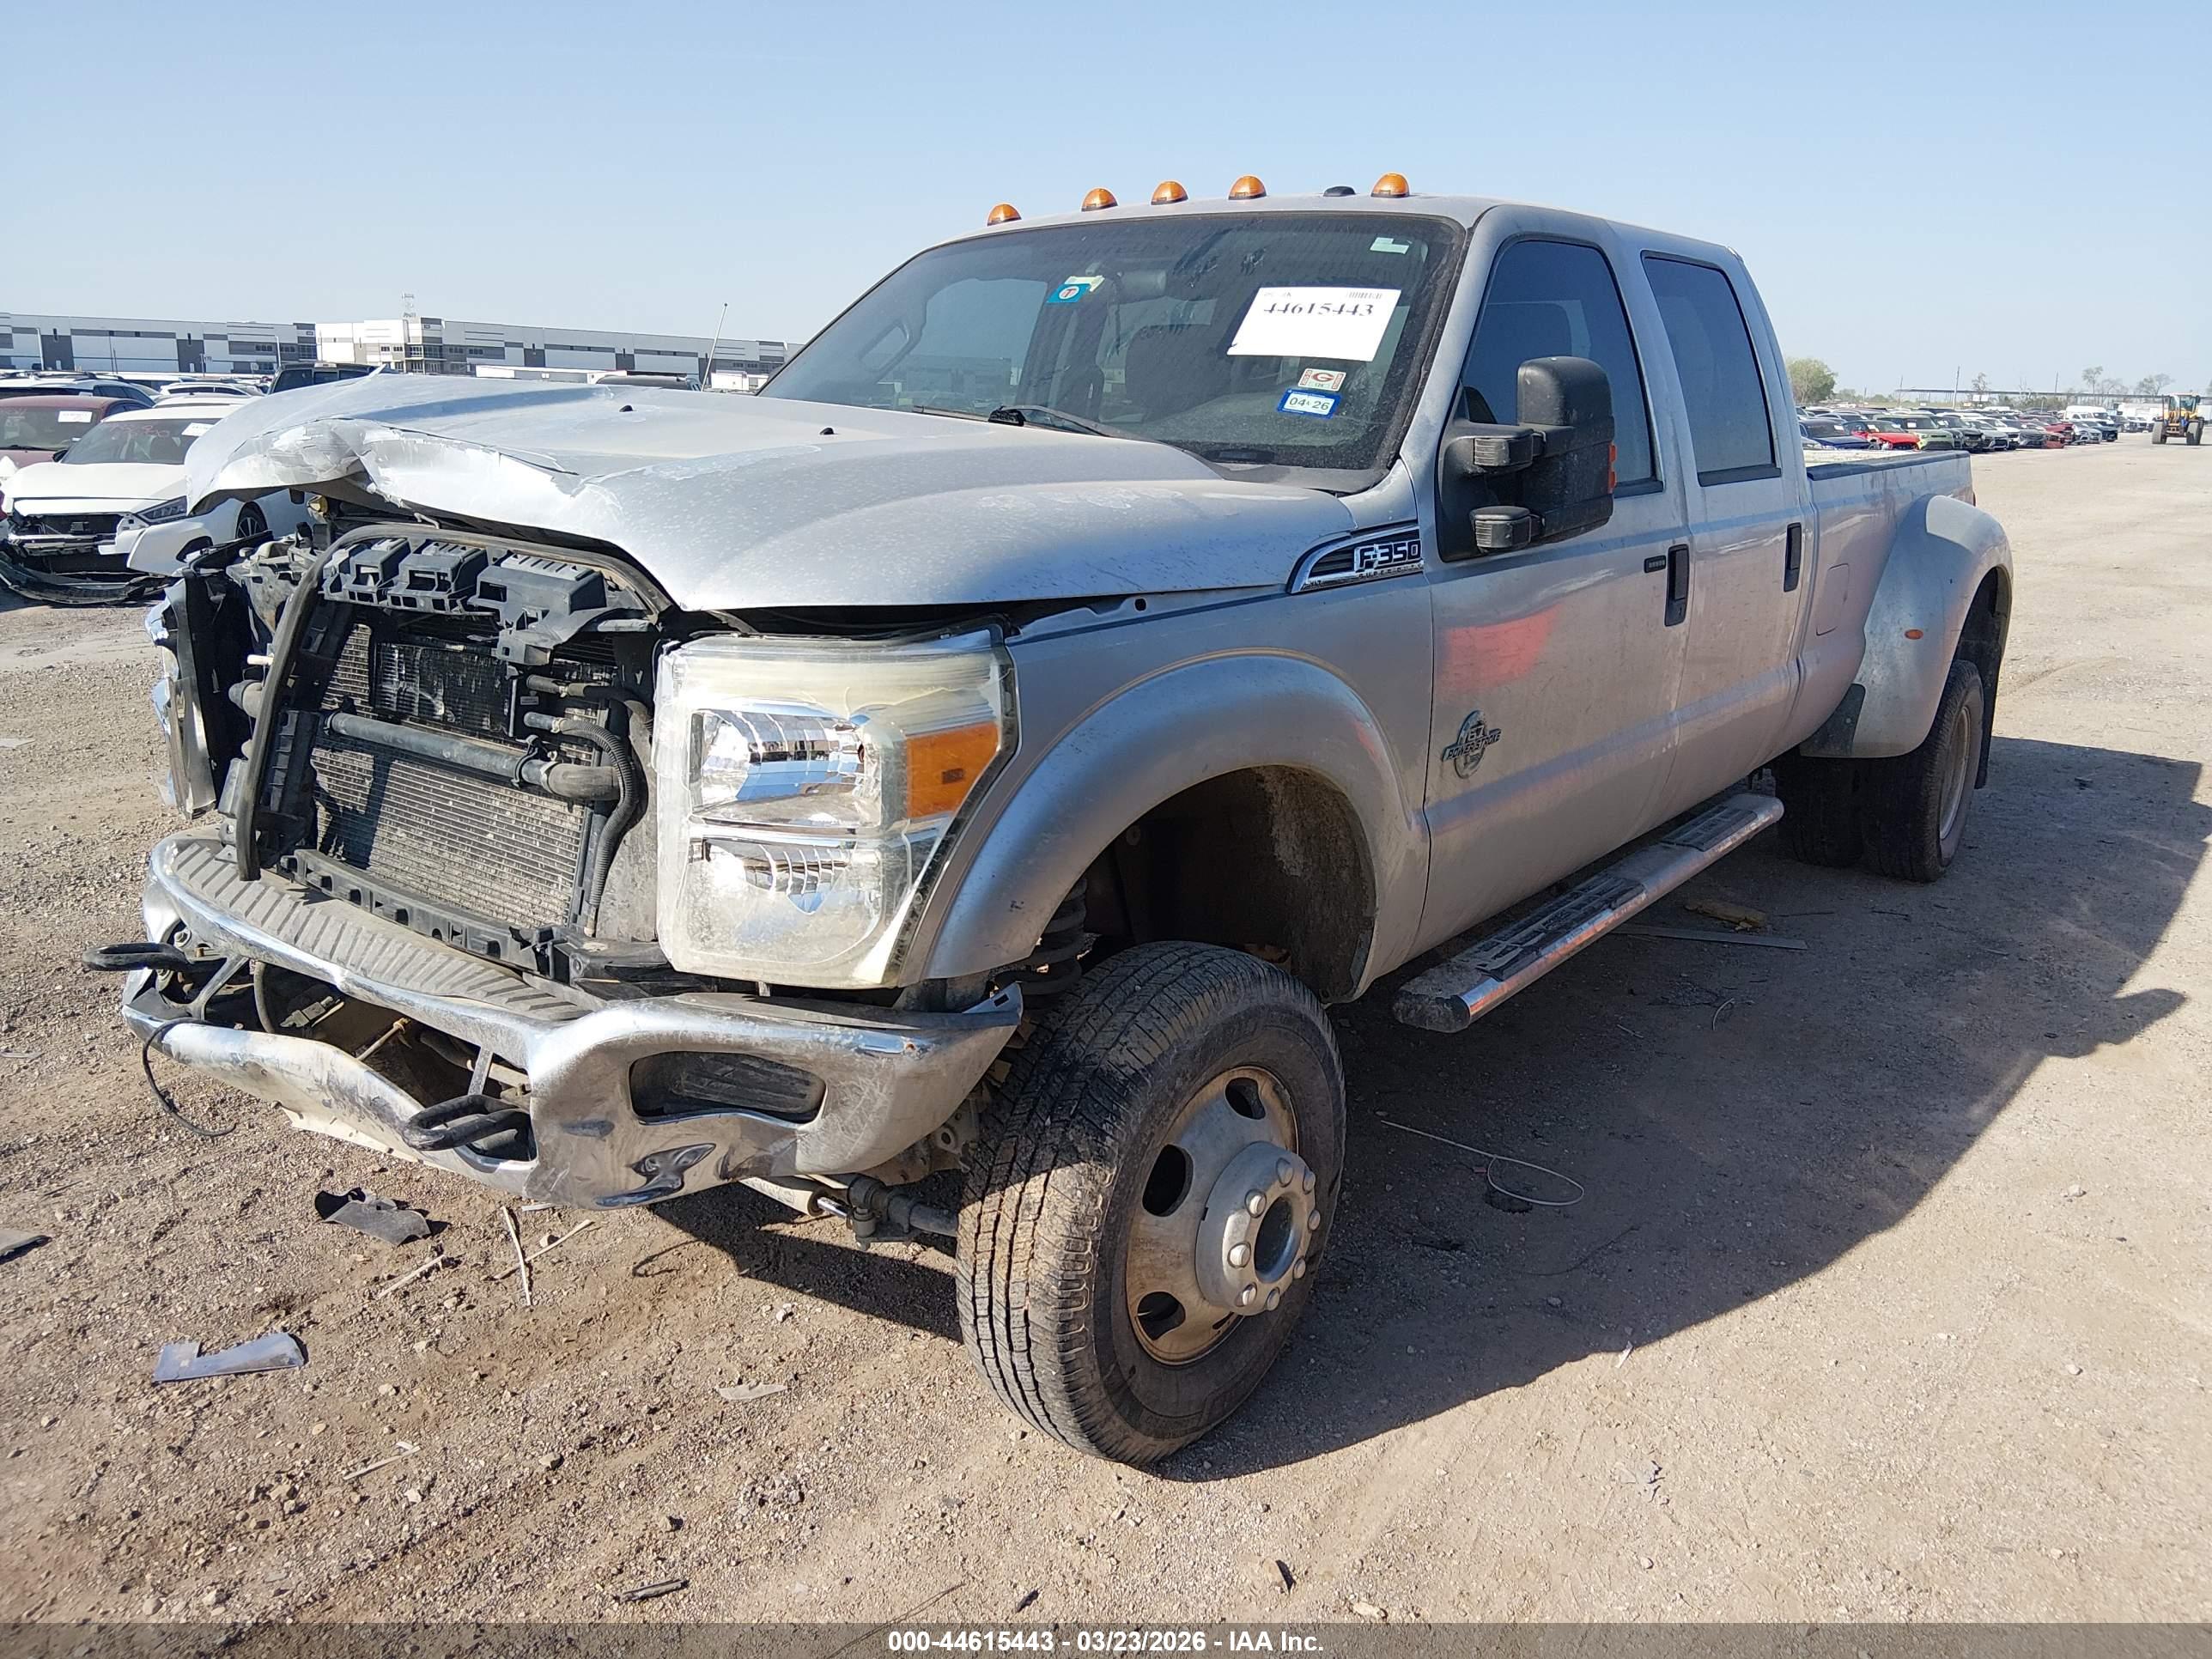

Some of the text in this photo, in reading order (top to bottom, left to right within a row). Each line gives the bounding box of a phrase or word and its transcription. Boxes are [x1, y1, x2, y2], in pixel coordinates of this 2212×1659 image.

[1263, 302, 1374, 317] 44615443
[1289, 397, 1331, 410] 04 26
